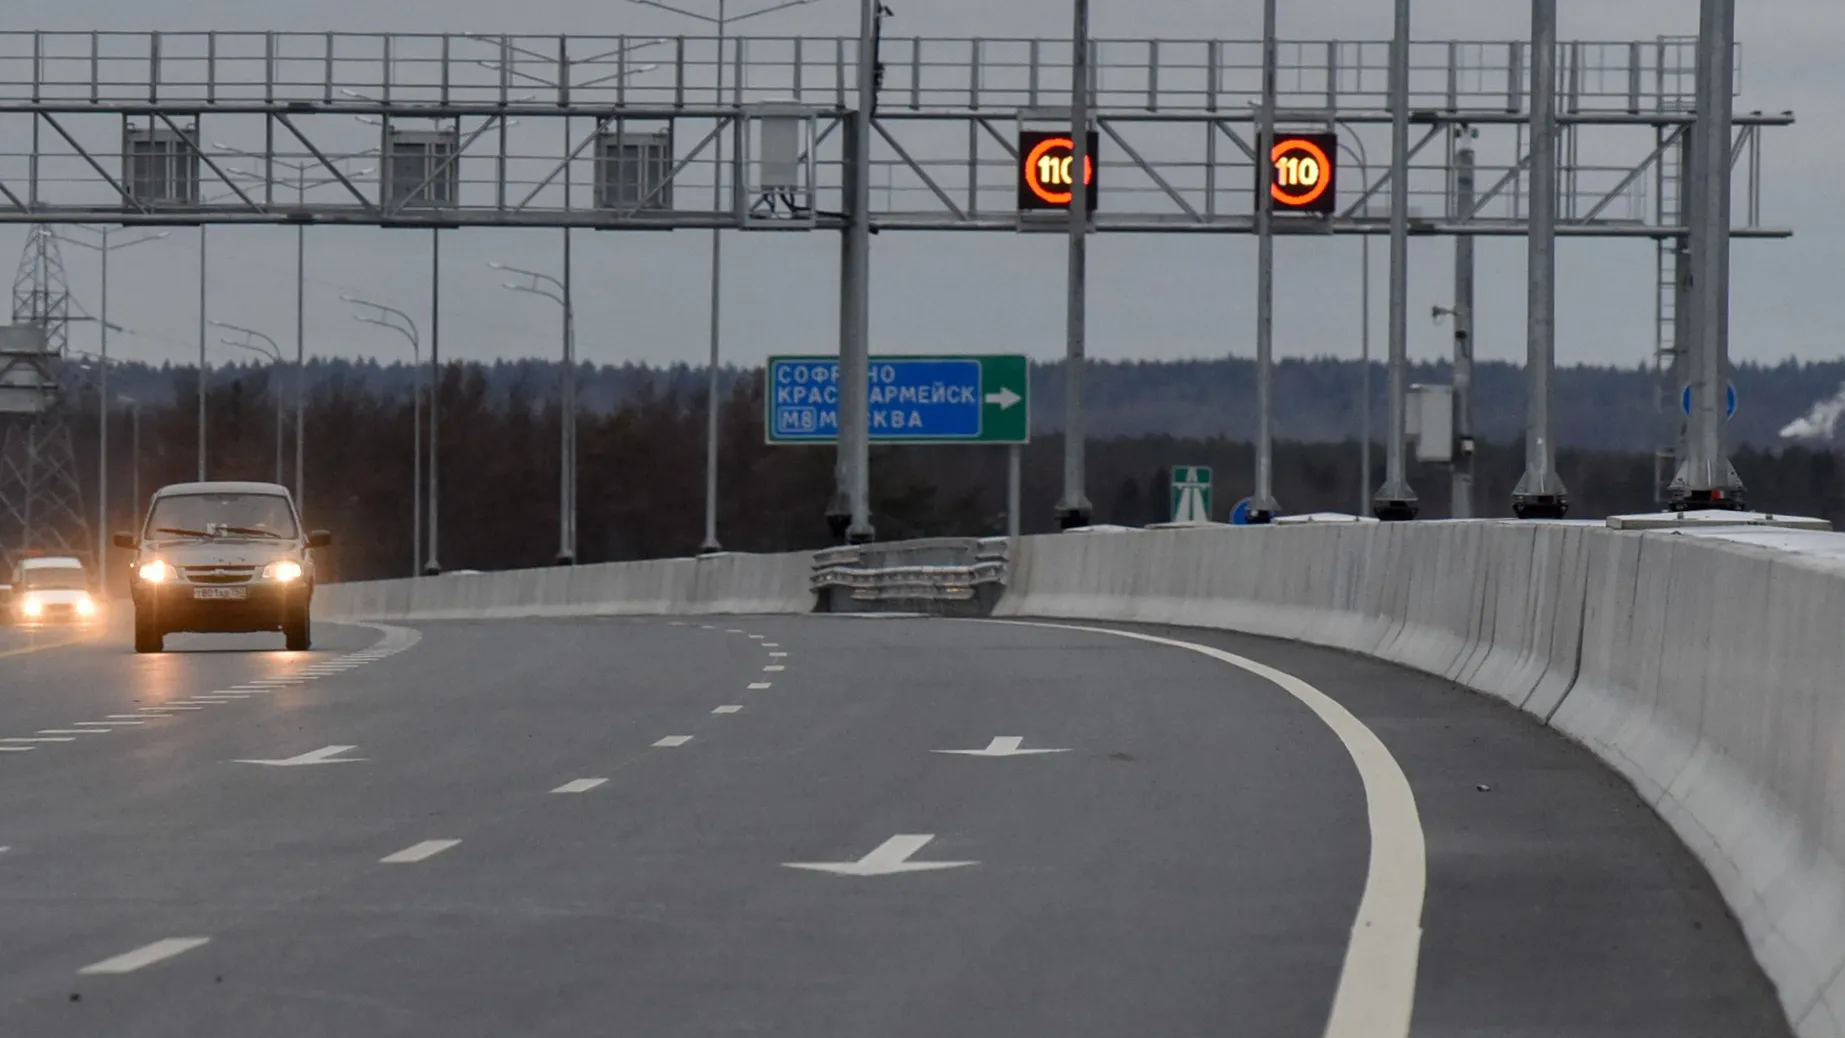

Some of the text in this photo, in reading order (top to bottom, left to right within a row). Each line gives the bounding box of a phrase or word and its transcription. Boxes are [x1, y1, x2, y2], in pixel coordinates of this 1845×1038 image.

[1274, 156, 1319, 186] 110
[778, 365, 896, 384] СОФРНО
[778, 381, 976, 404] КРАСАРМЕЙСК
[820, 409, 924, 429] МКВА
